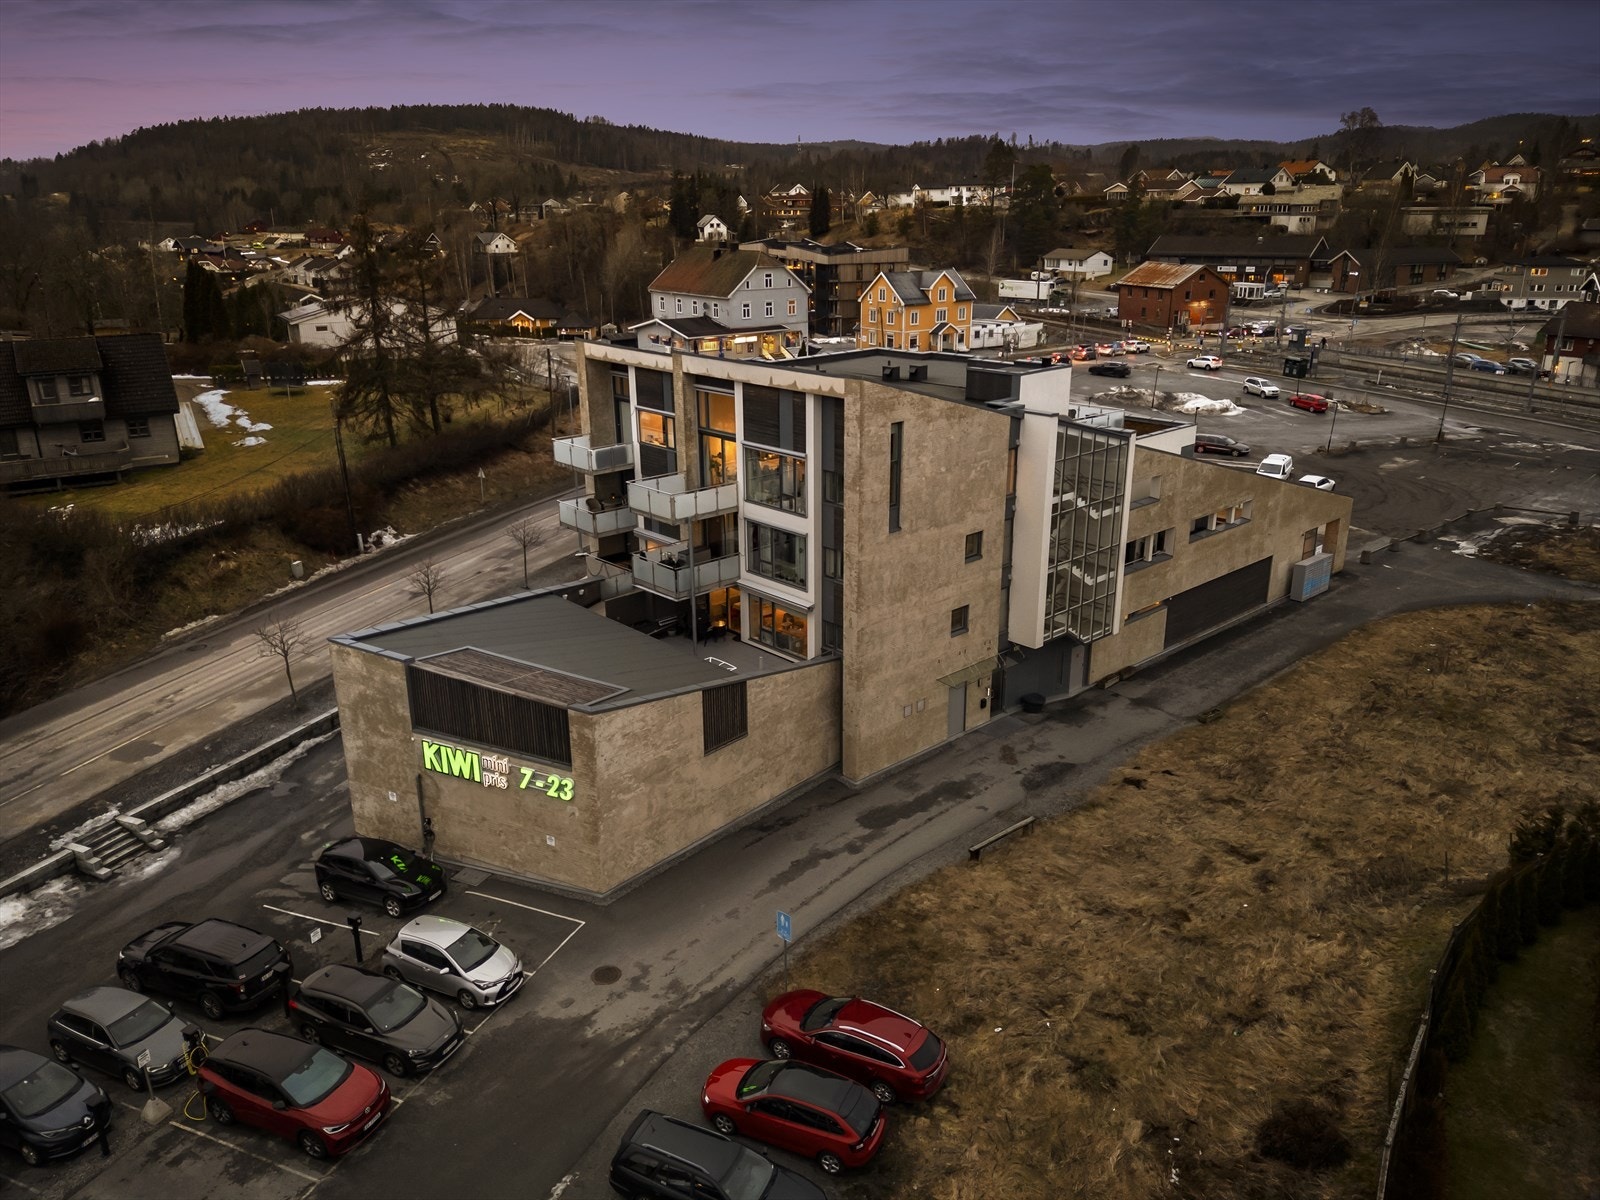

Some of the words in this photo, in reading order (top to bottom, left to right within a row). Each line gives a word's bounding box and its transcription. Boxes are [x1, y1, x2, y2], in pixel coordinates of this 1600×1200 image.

[422, 740, 481, 783] KIWI
[482, 755, 510, 774] mini
[482, 772, 509, 790] pris
